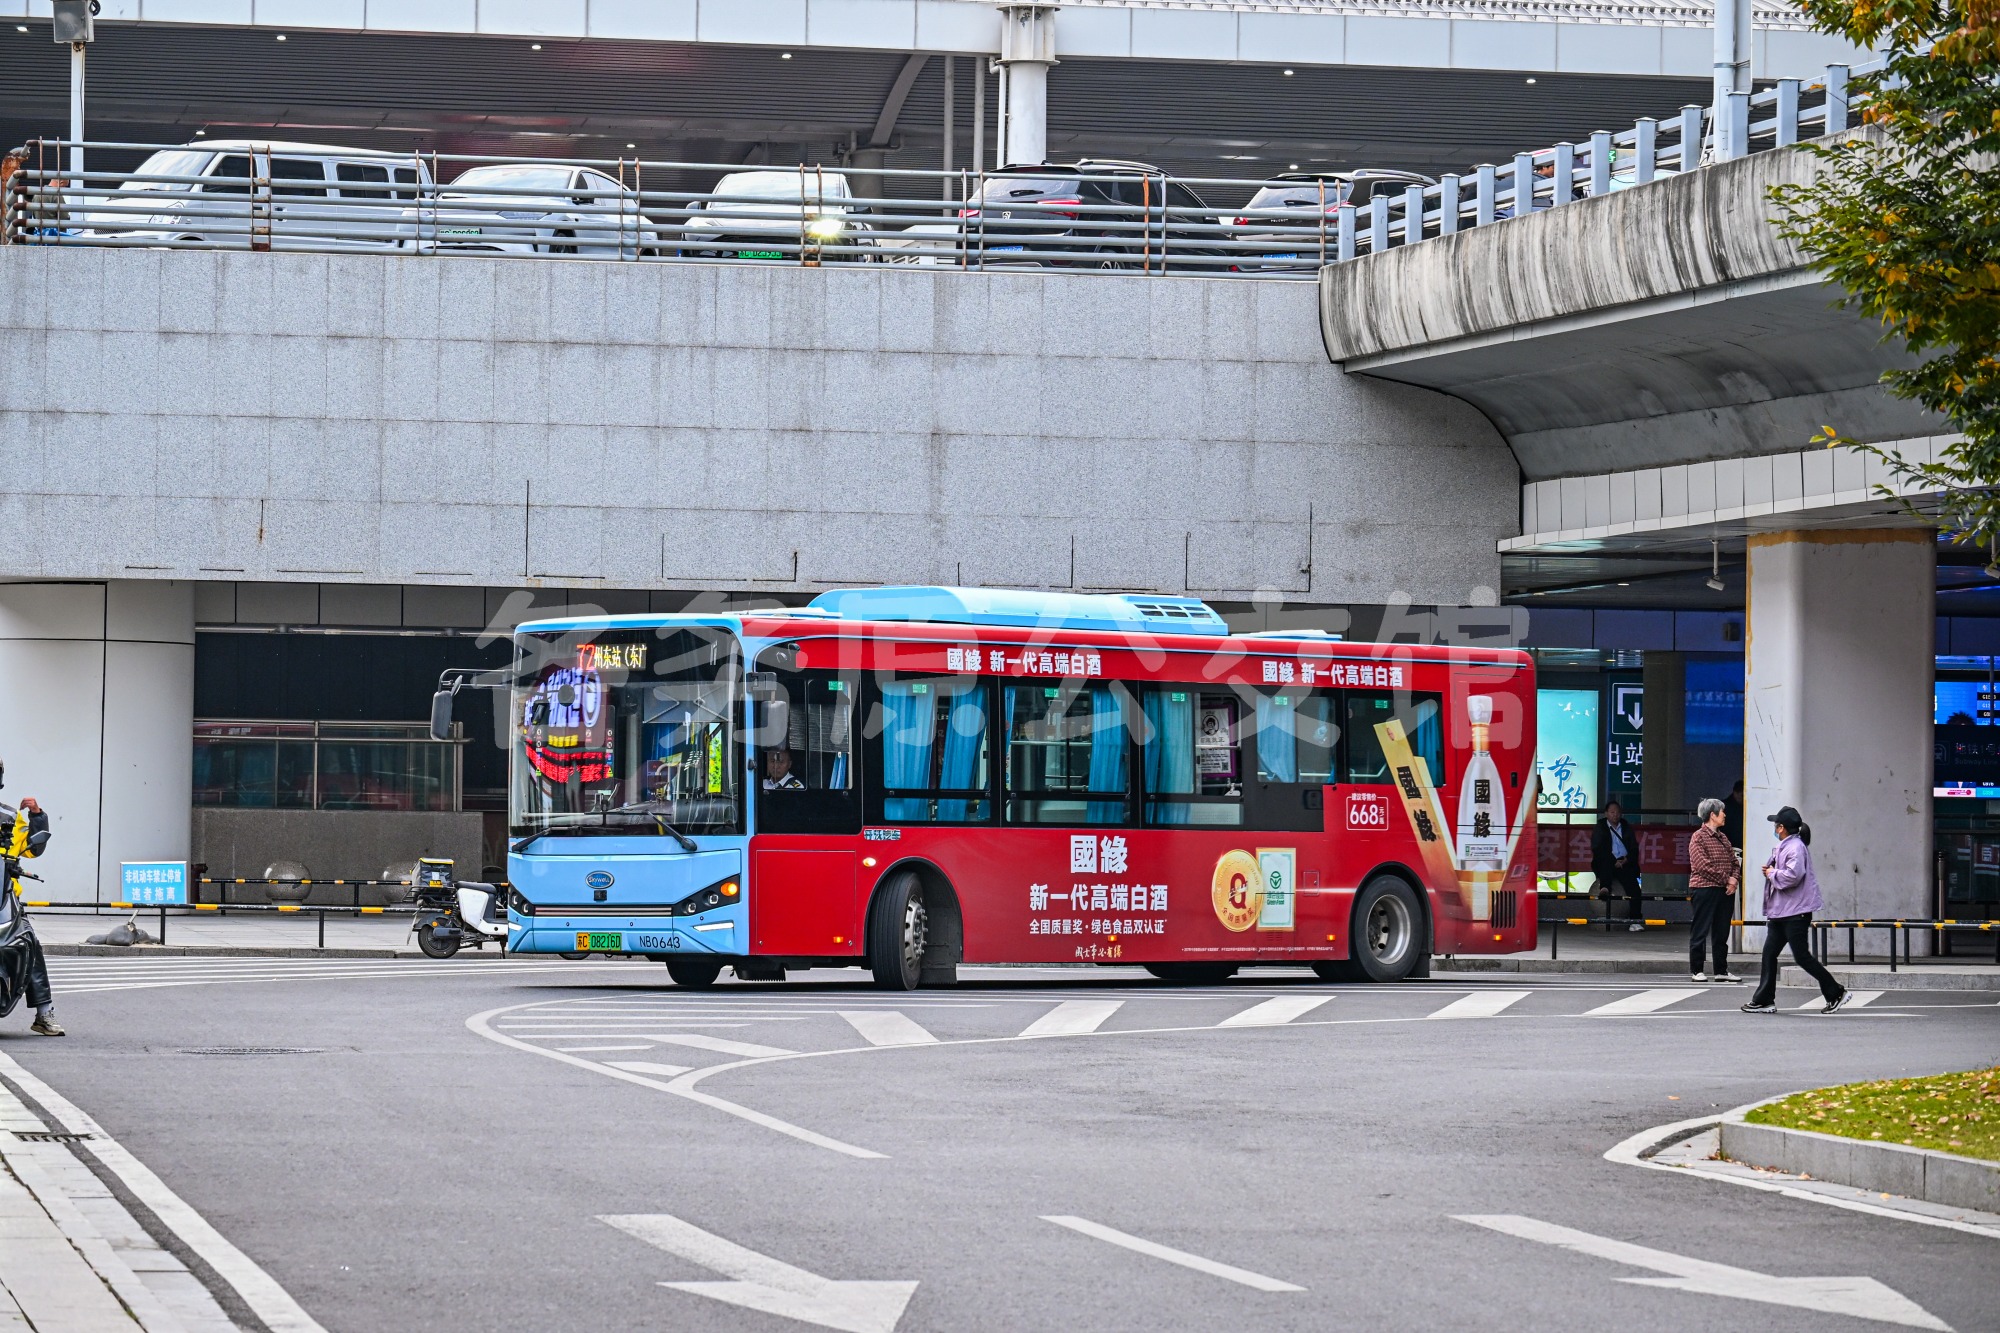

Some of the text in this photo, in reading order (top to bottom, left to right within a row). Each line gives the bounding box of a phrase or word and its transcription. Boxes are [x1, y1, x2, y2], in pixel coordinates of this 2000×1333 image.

[576, 644, 596, 670] 72
[946, 648, 1102, 675] 國緣 新一代高端白酒
[1262, 660, 1404, 687] 國緣 新一代高端白酒
[1955, 742, 2000, 757] 地铁1号
[1350, 804, 1379, 825] 668
[1070, 834, 1128, 873] 國緣
[125, 868, 182, 884] 非机动车禁止停放
[1029, 883, 1168, 911] 新一代高端白酒
[639, 935, 681, 949] NB0643
